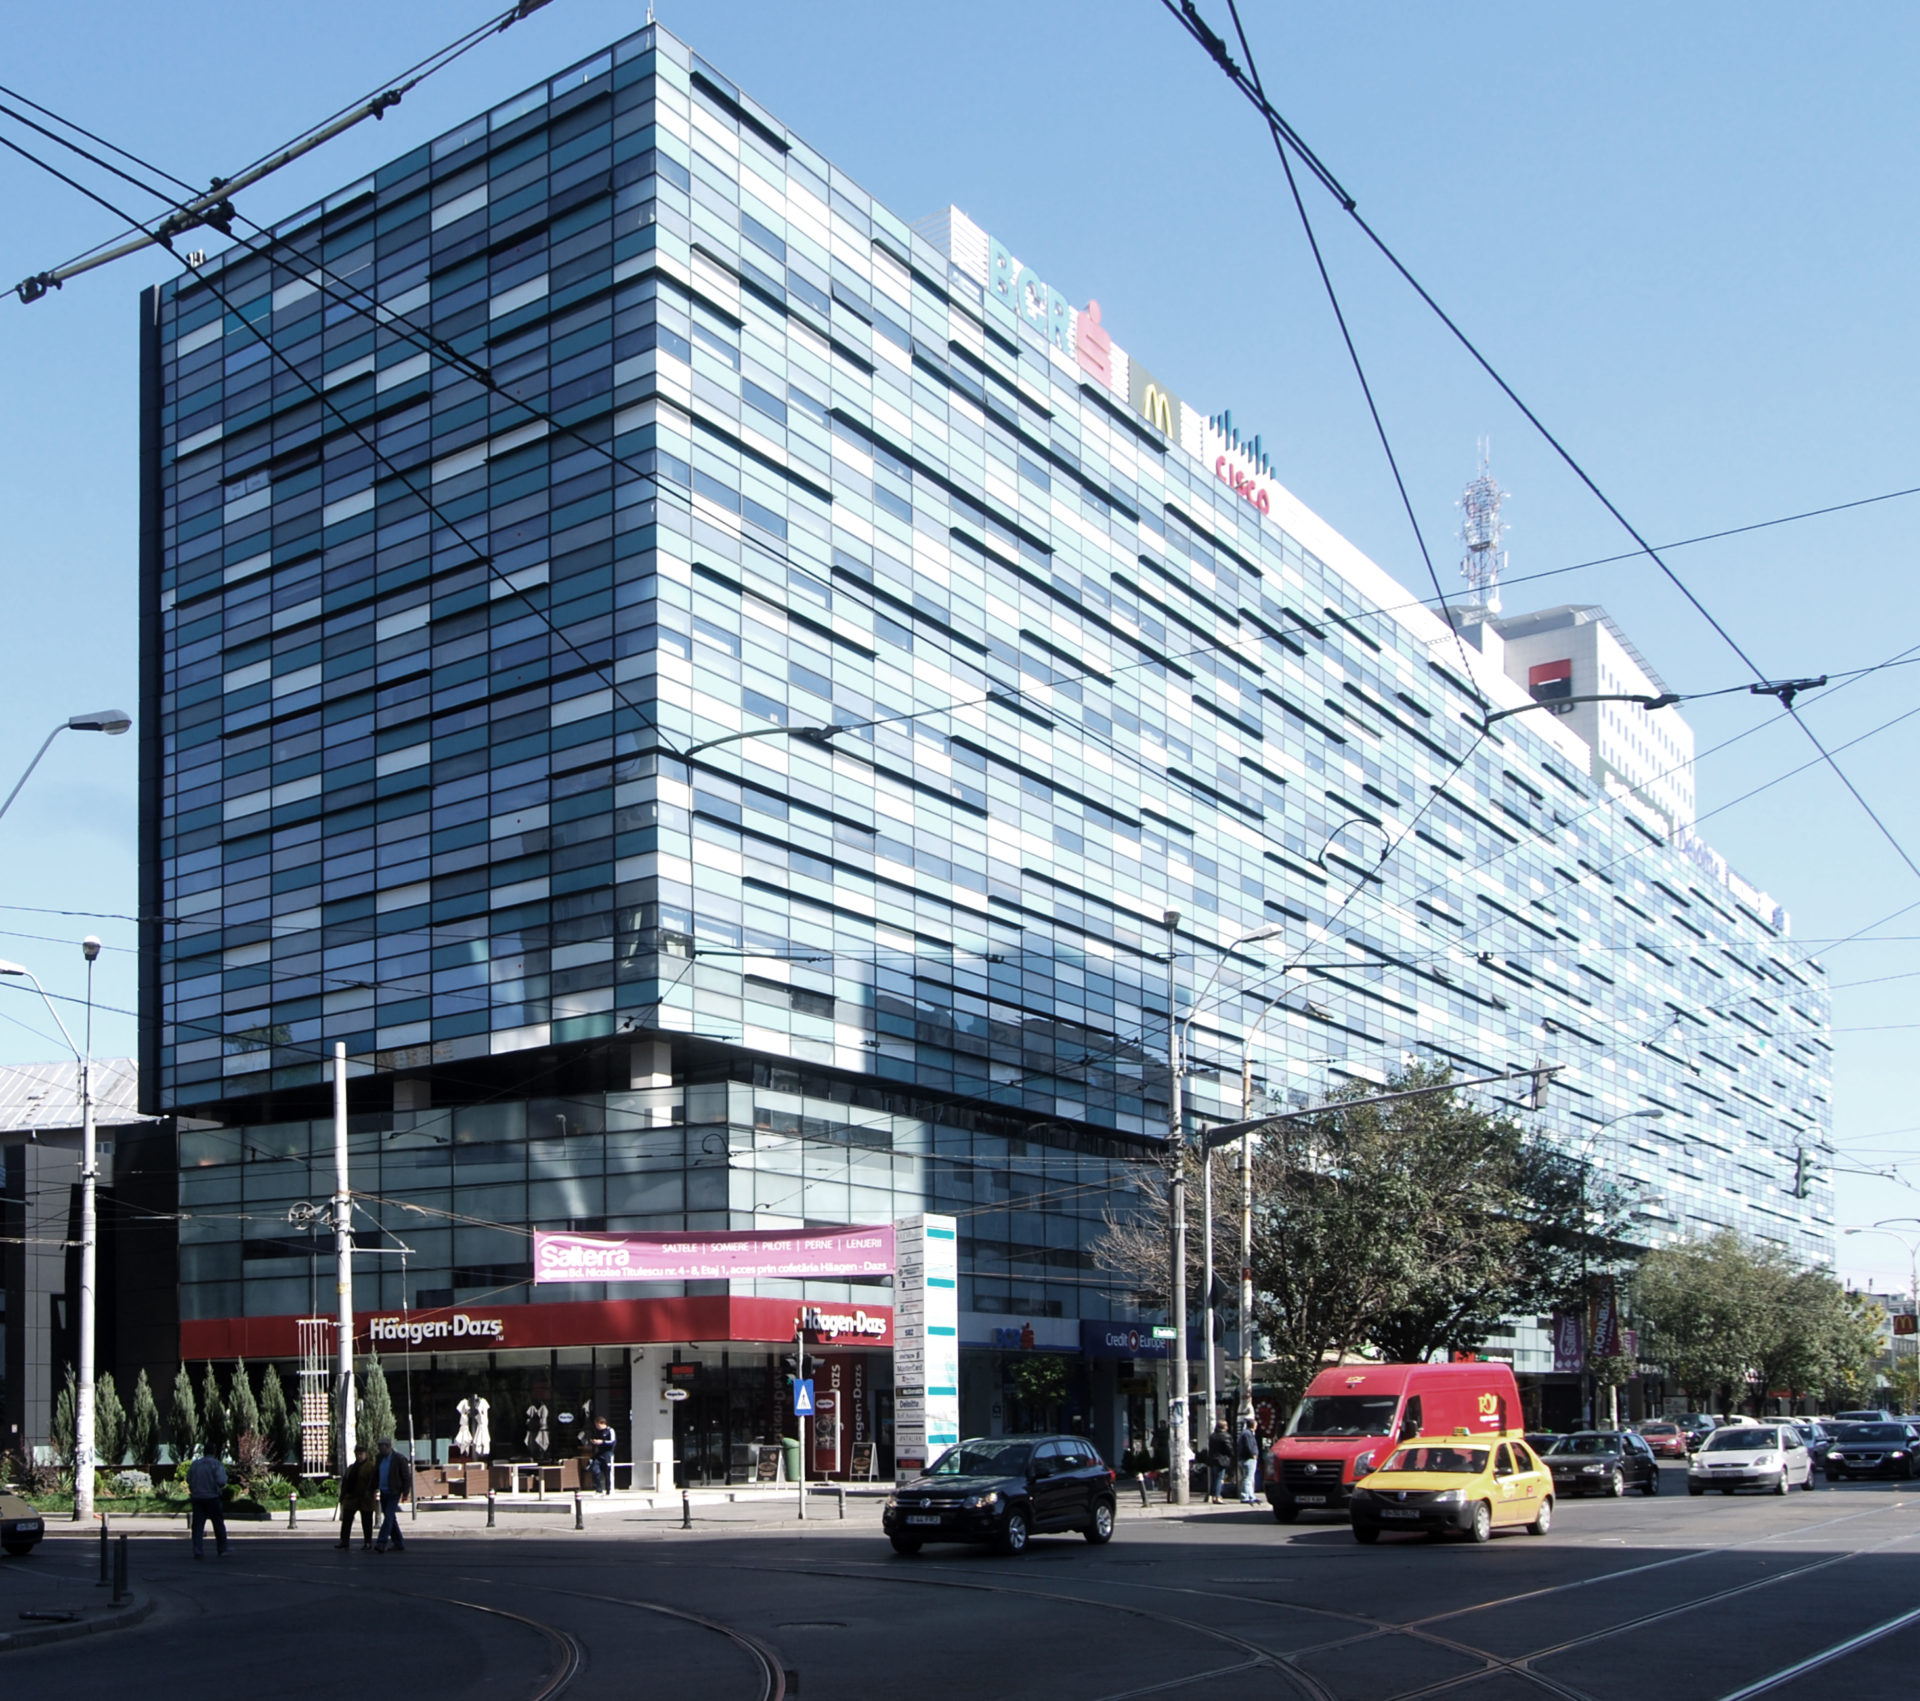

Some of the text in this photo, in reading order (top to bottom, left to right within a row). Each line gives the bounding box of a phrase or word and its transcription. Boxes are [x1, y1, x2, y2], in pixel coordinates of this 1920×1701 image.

[989, 235, 1070, 357] BCR
[541, 1246, 629, 1267] Salterra
[662, 1239, 882, 1253] SALTELE SOMIERE PILOTE PERNE LENJERII
[585, 1267, 621, 1277] Nicolae
[622, 1266, 663, 1277] Titulescu
[679, 1267, 685, 1275] 4
[701, 1266, 719, 1277] Etaj
[730, 1266, 755, 1275] acces
[757, 1264, 776, 1275] prin
[821, 1262, 857, 1274] Häagen
[864, 1261, 887, 1271] Dazs
[370, 1315, 503, 1344] Häagen-Dazs
[802, 1306, 887, 1337] Häagen-Dazs
[1106, 1332, 1166, 1350] Credit Europe
